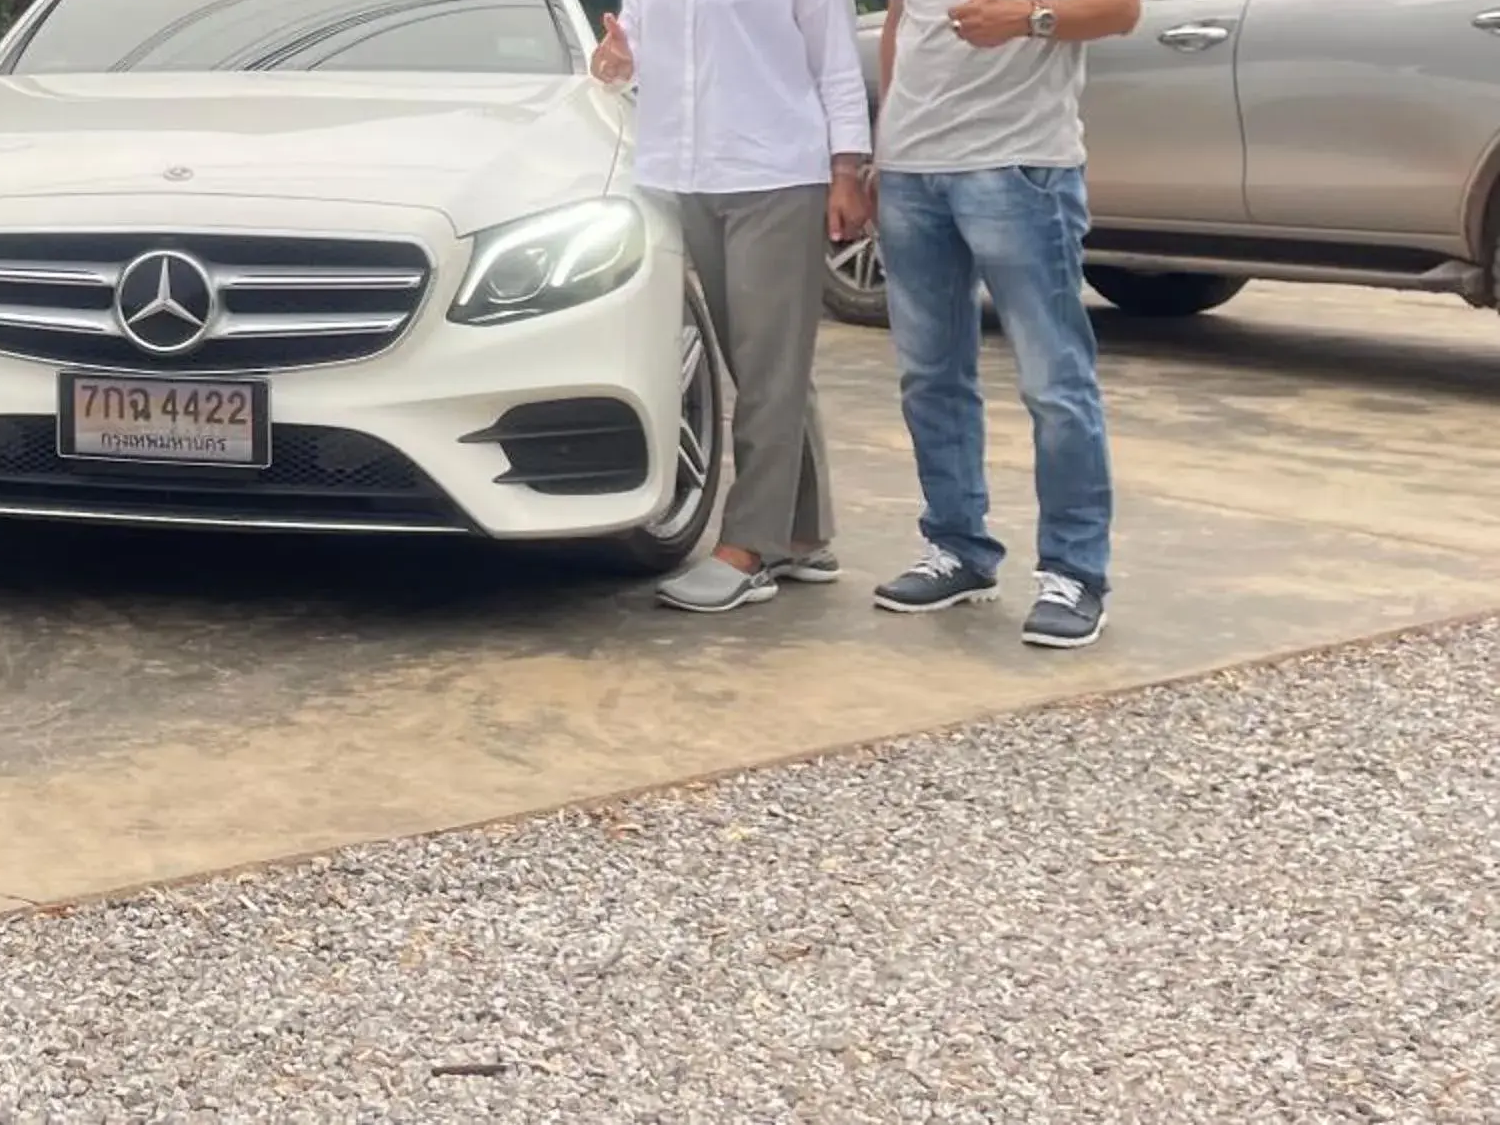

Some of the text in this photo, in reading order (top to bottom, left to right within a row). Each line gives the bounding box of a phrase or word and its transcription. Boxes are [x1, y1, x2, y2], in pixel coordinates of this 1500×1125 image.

[81, 384, 249, 426] 7กฉ 4422
[101, 431, 228, 454] กรุงเทพมหานคร
